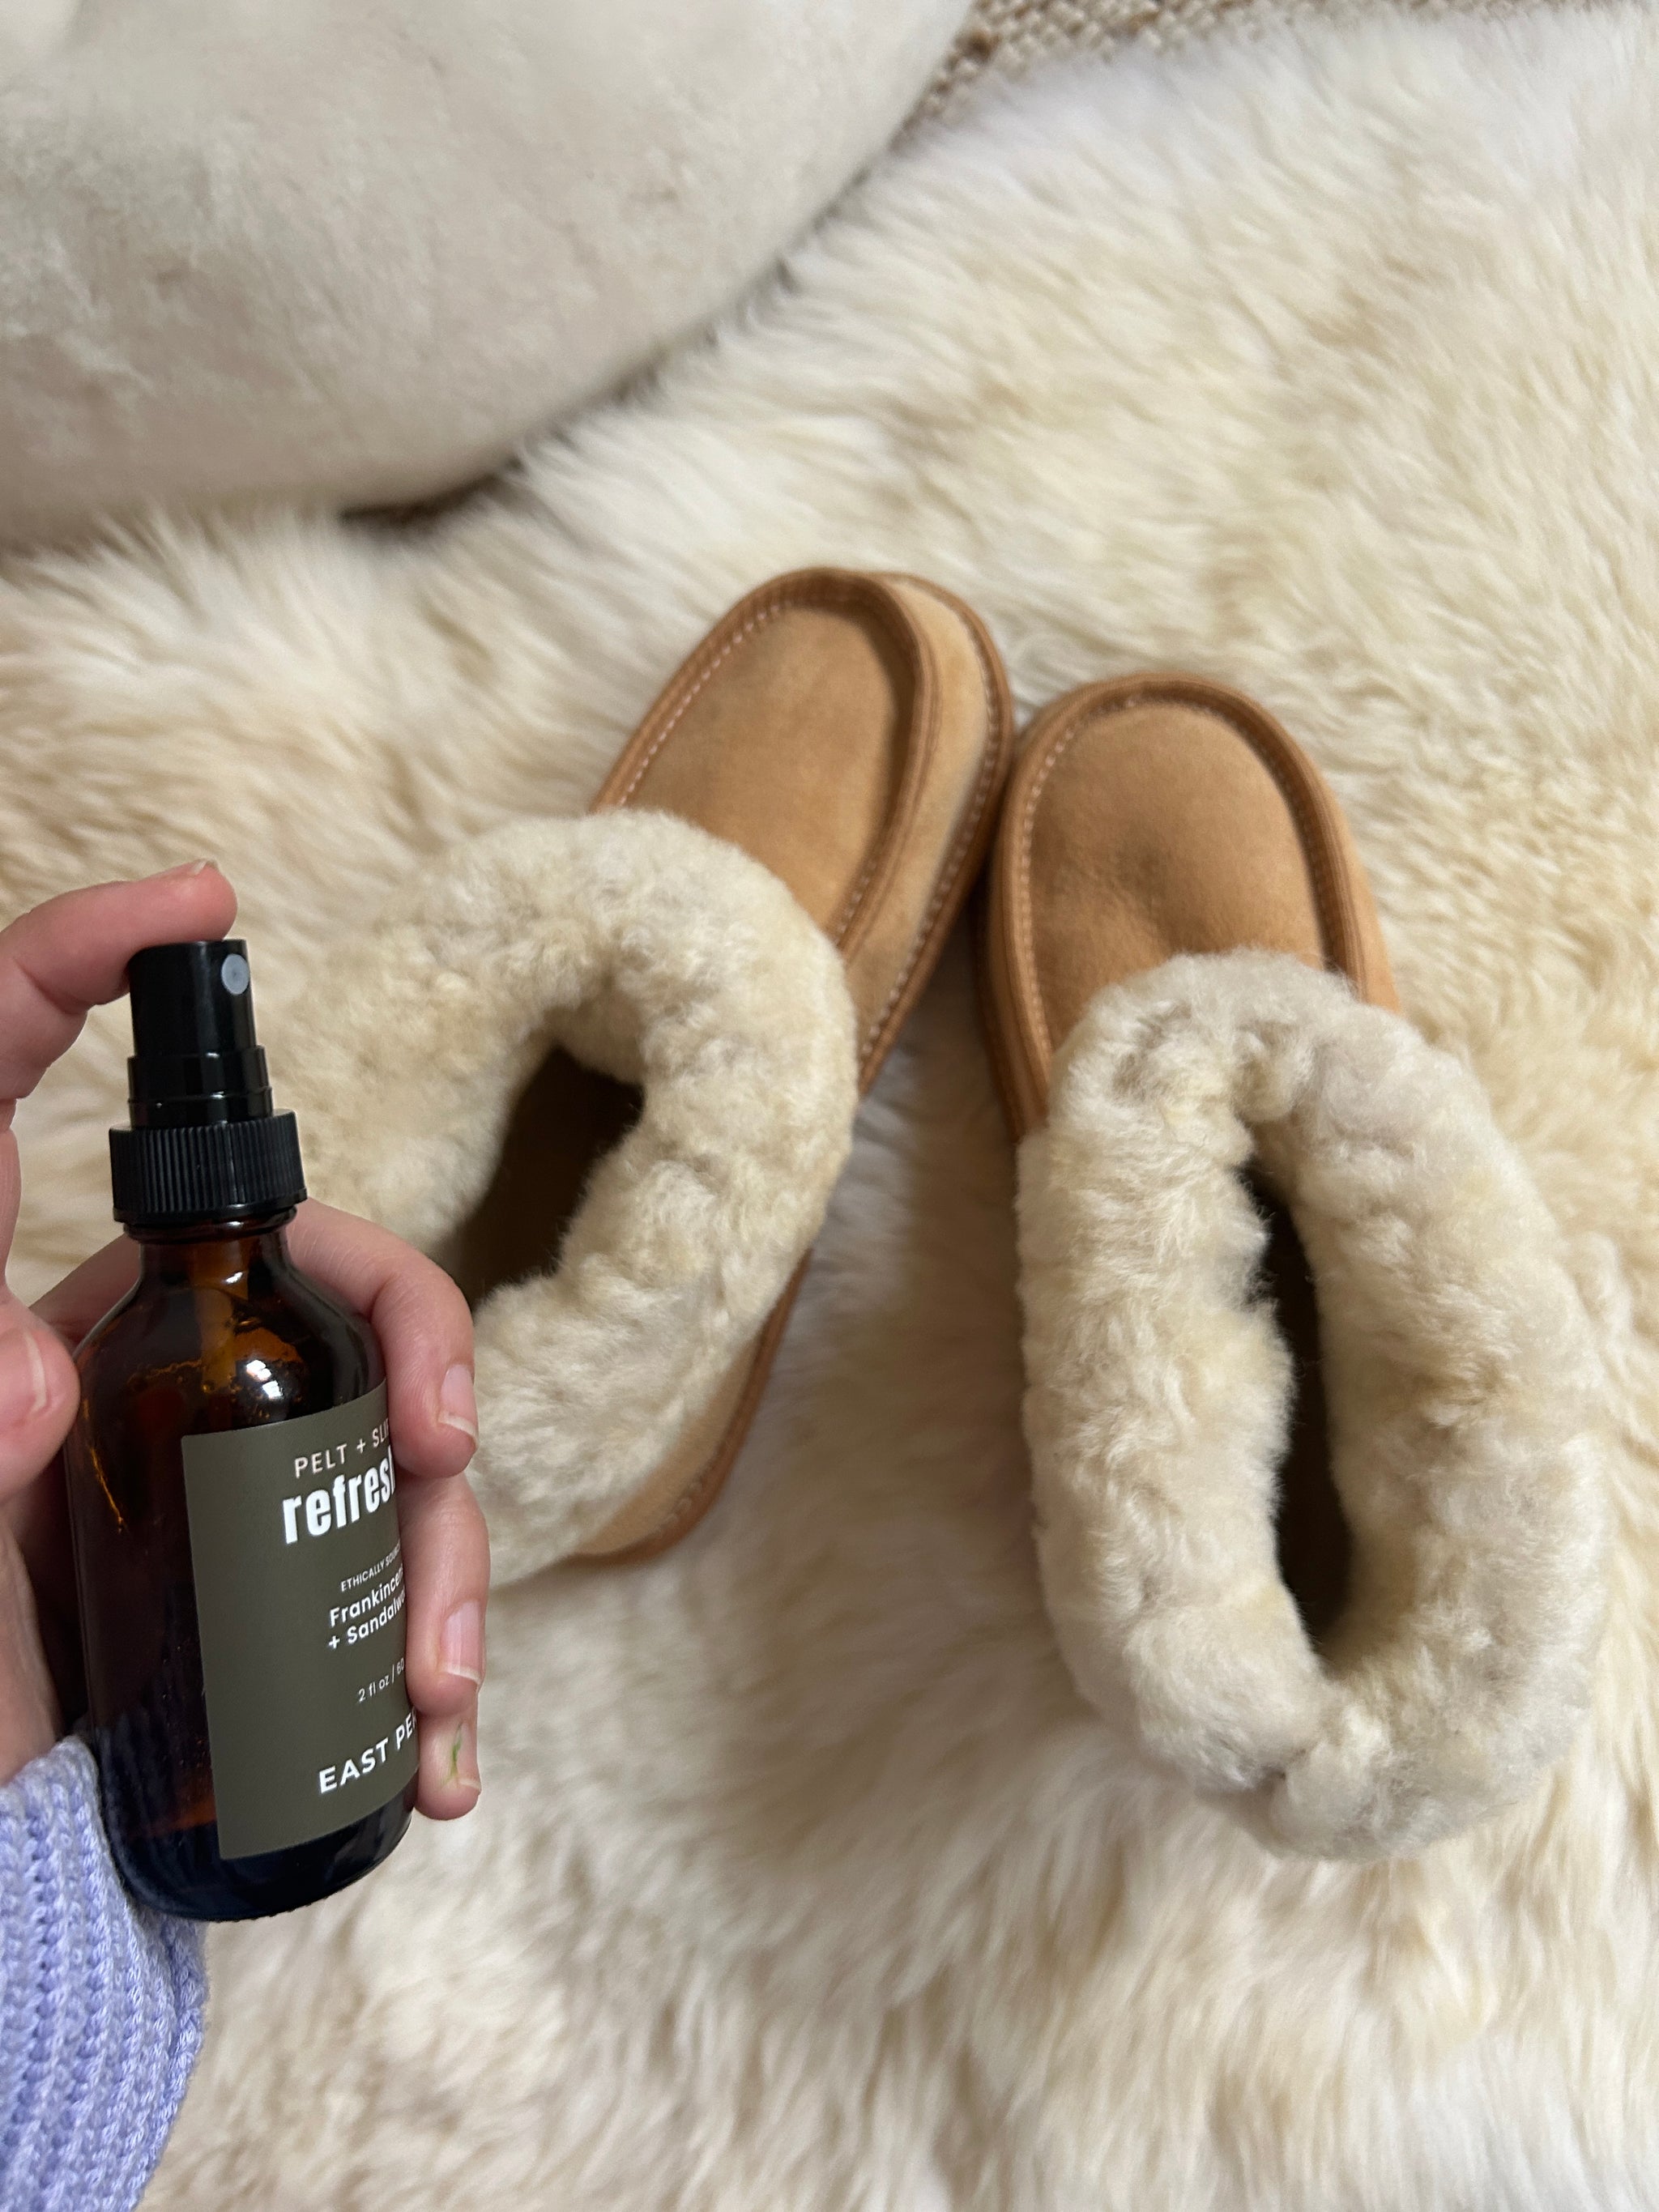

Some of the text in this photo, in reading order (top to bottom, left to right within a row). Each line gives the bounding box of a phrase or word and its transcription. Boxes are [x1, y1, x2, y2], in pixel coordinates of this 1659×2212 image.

[294, 1443, 348, 1478] PELT
[356, 1438, 365, 1453] +
[340, 1561, 385, 1592] ETHICALLY
[328, 1635, 340, 1649] +
[357, 1688, 366, 1703] 2
[369, 1681, 376, 1697] fl
[379, 1675, 390, 1690] oz
[319, 1737, 389, 1793] EAST
